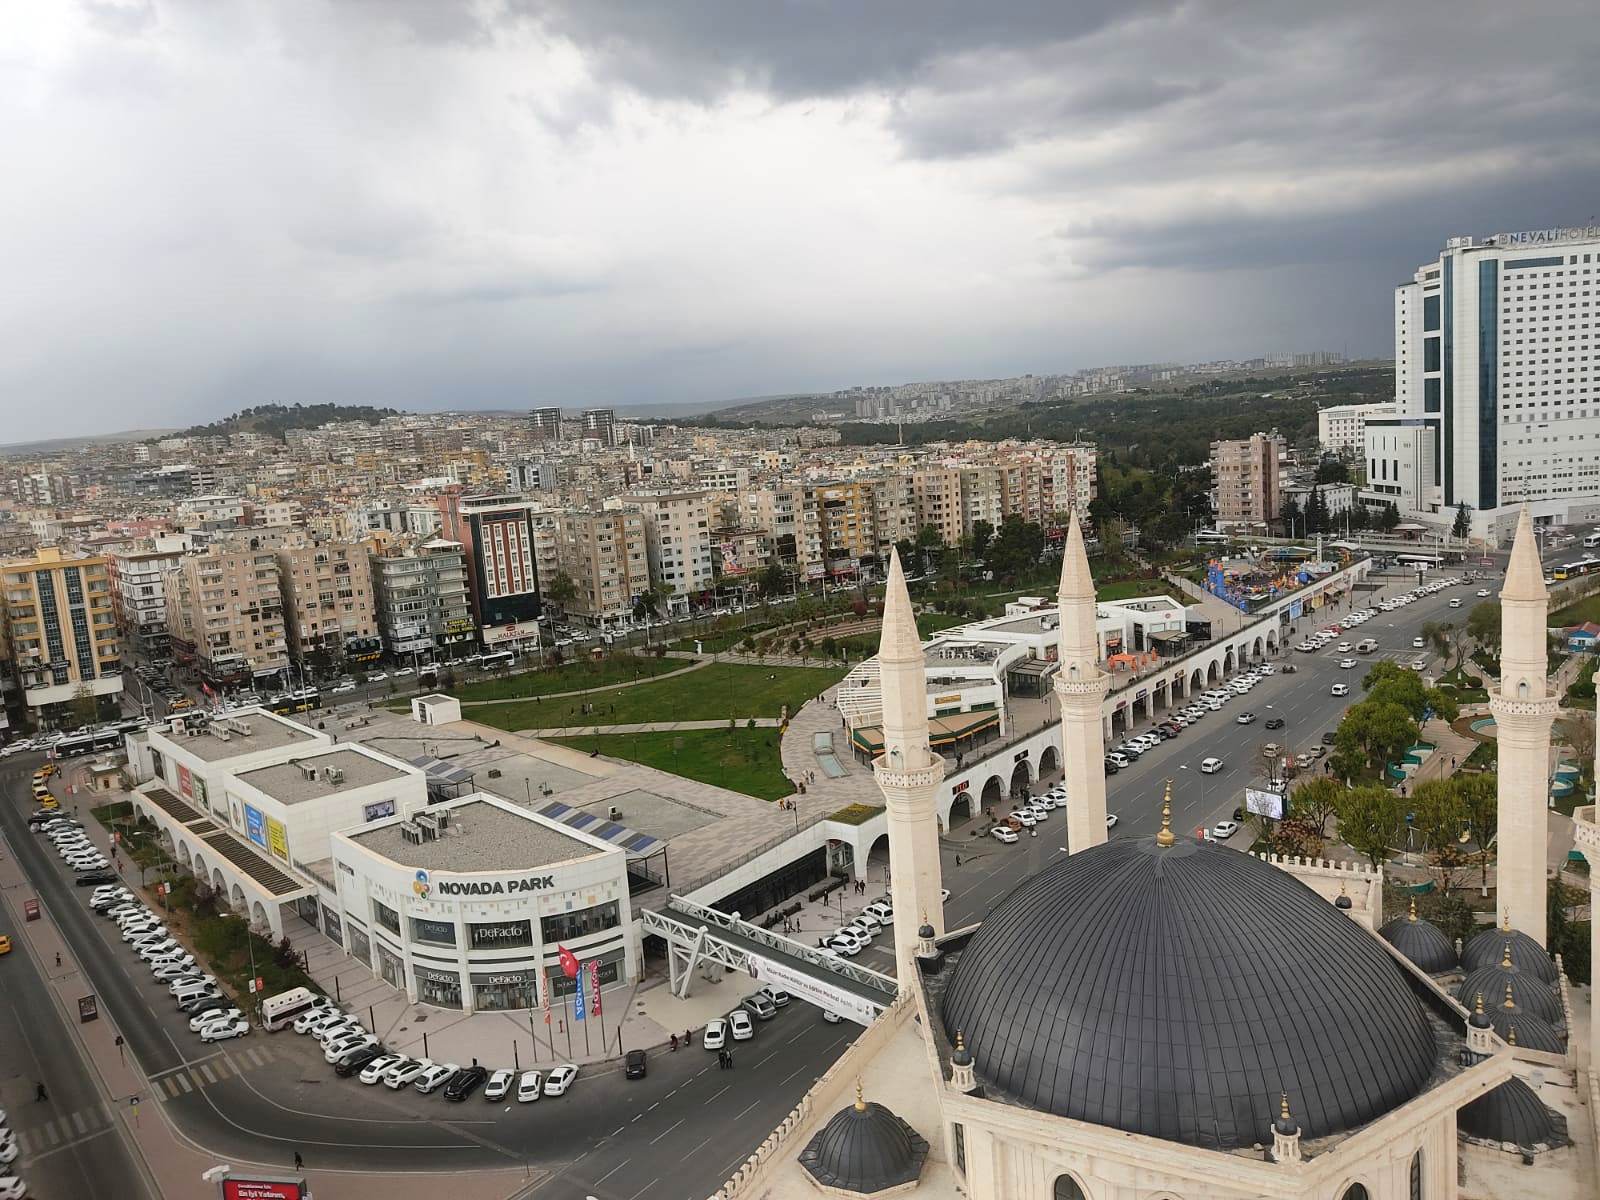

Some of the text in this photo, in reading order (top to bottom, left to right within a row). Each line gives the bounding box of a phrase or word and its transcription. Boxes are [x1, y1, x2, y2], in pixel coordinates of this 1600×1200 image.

[1560, 227, 1600, 240] HOTEL
[438, 875, 554, 895] NOVADA PARK
[479, 926, 523, 938] DeFacto
[427, 971, 454, 983] DeFacto
[488, 975, 522, 984] DeFacto
